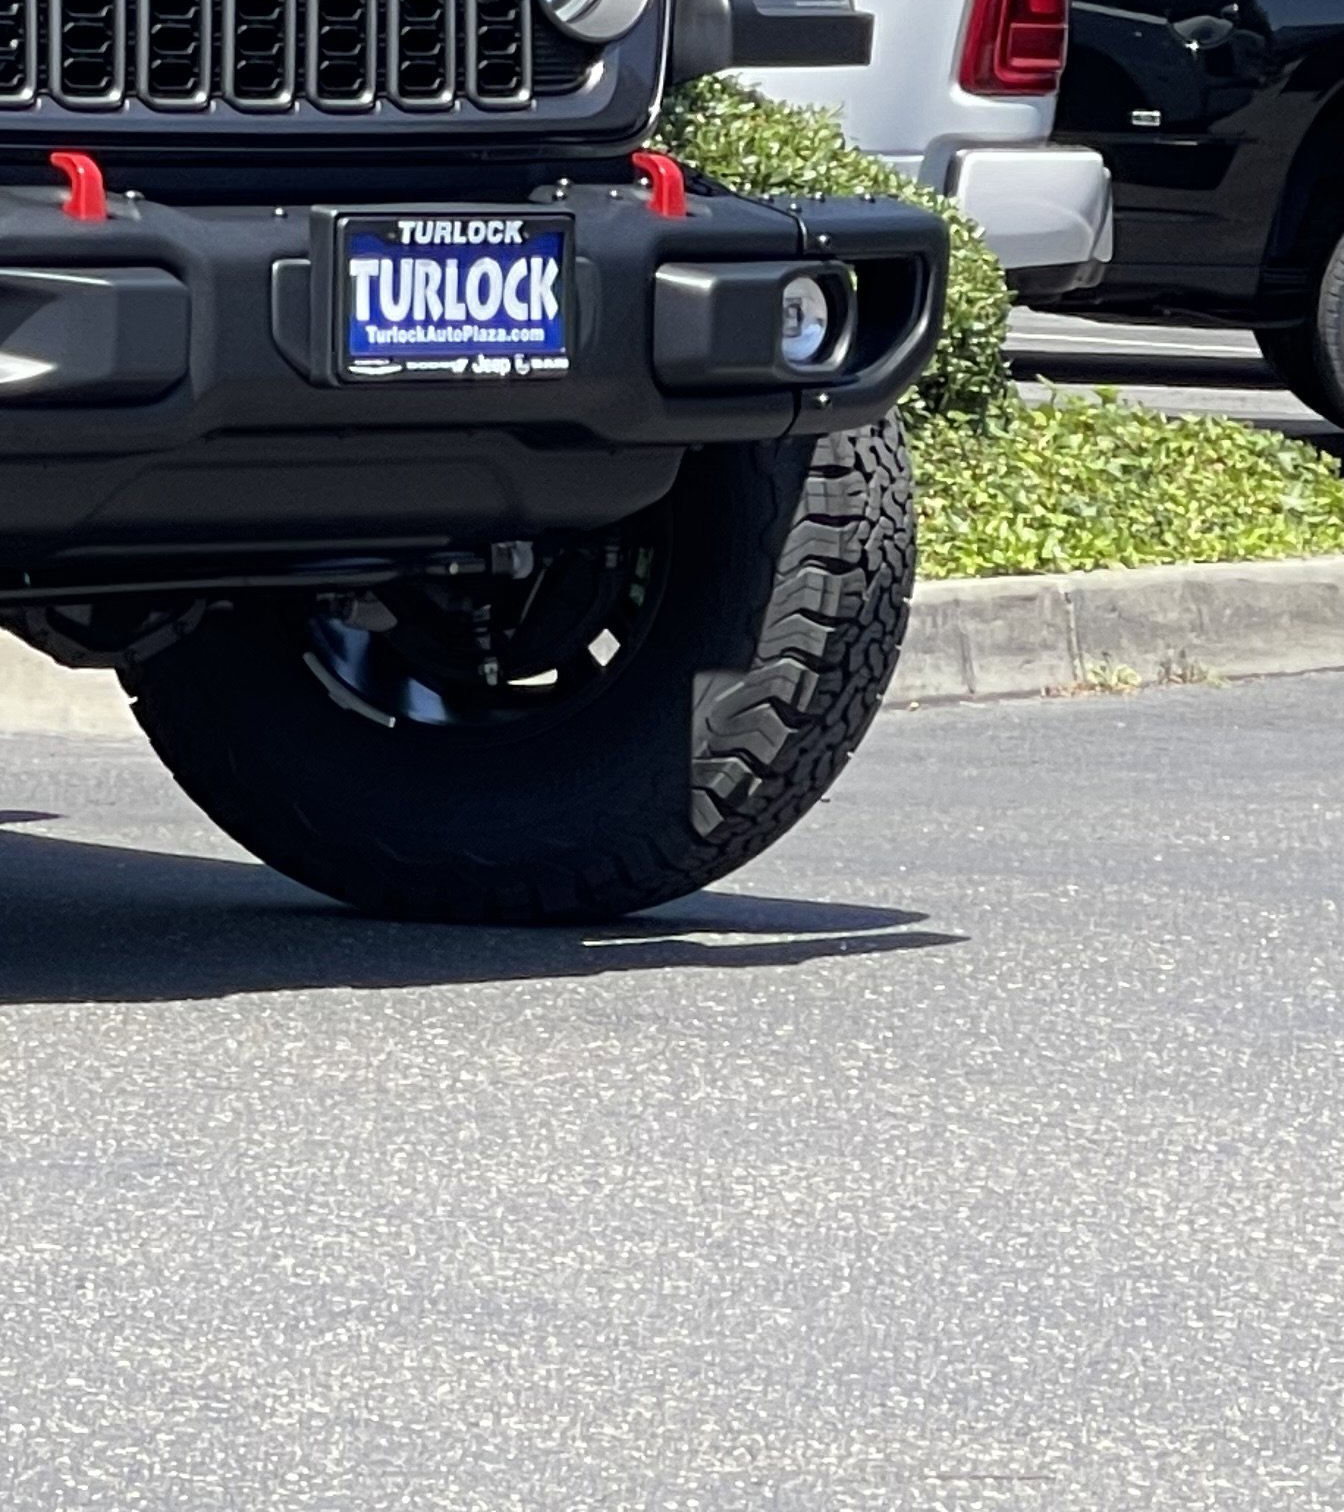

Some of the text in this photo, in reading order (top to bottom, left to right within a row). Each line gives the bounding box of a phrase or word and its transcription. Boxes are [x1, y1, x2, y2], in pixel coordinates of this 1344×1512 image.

[398, 221, 524, 244] TURLOCK
[349, 257, 560, 321] TURLOCK
[365, 325, 545, 344] TurlockAutoPlaza.com
